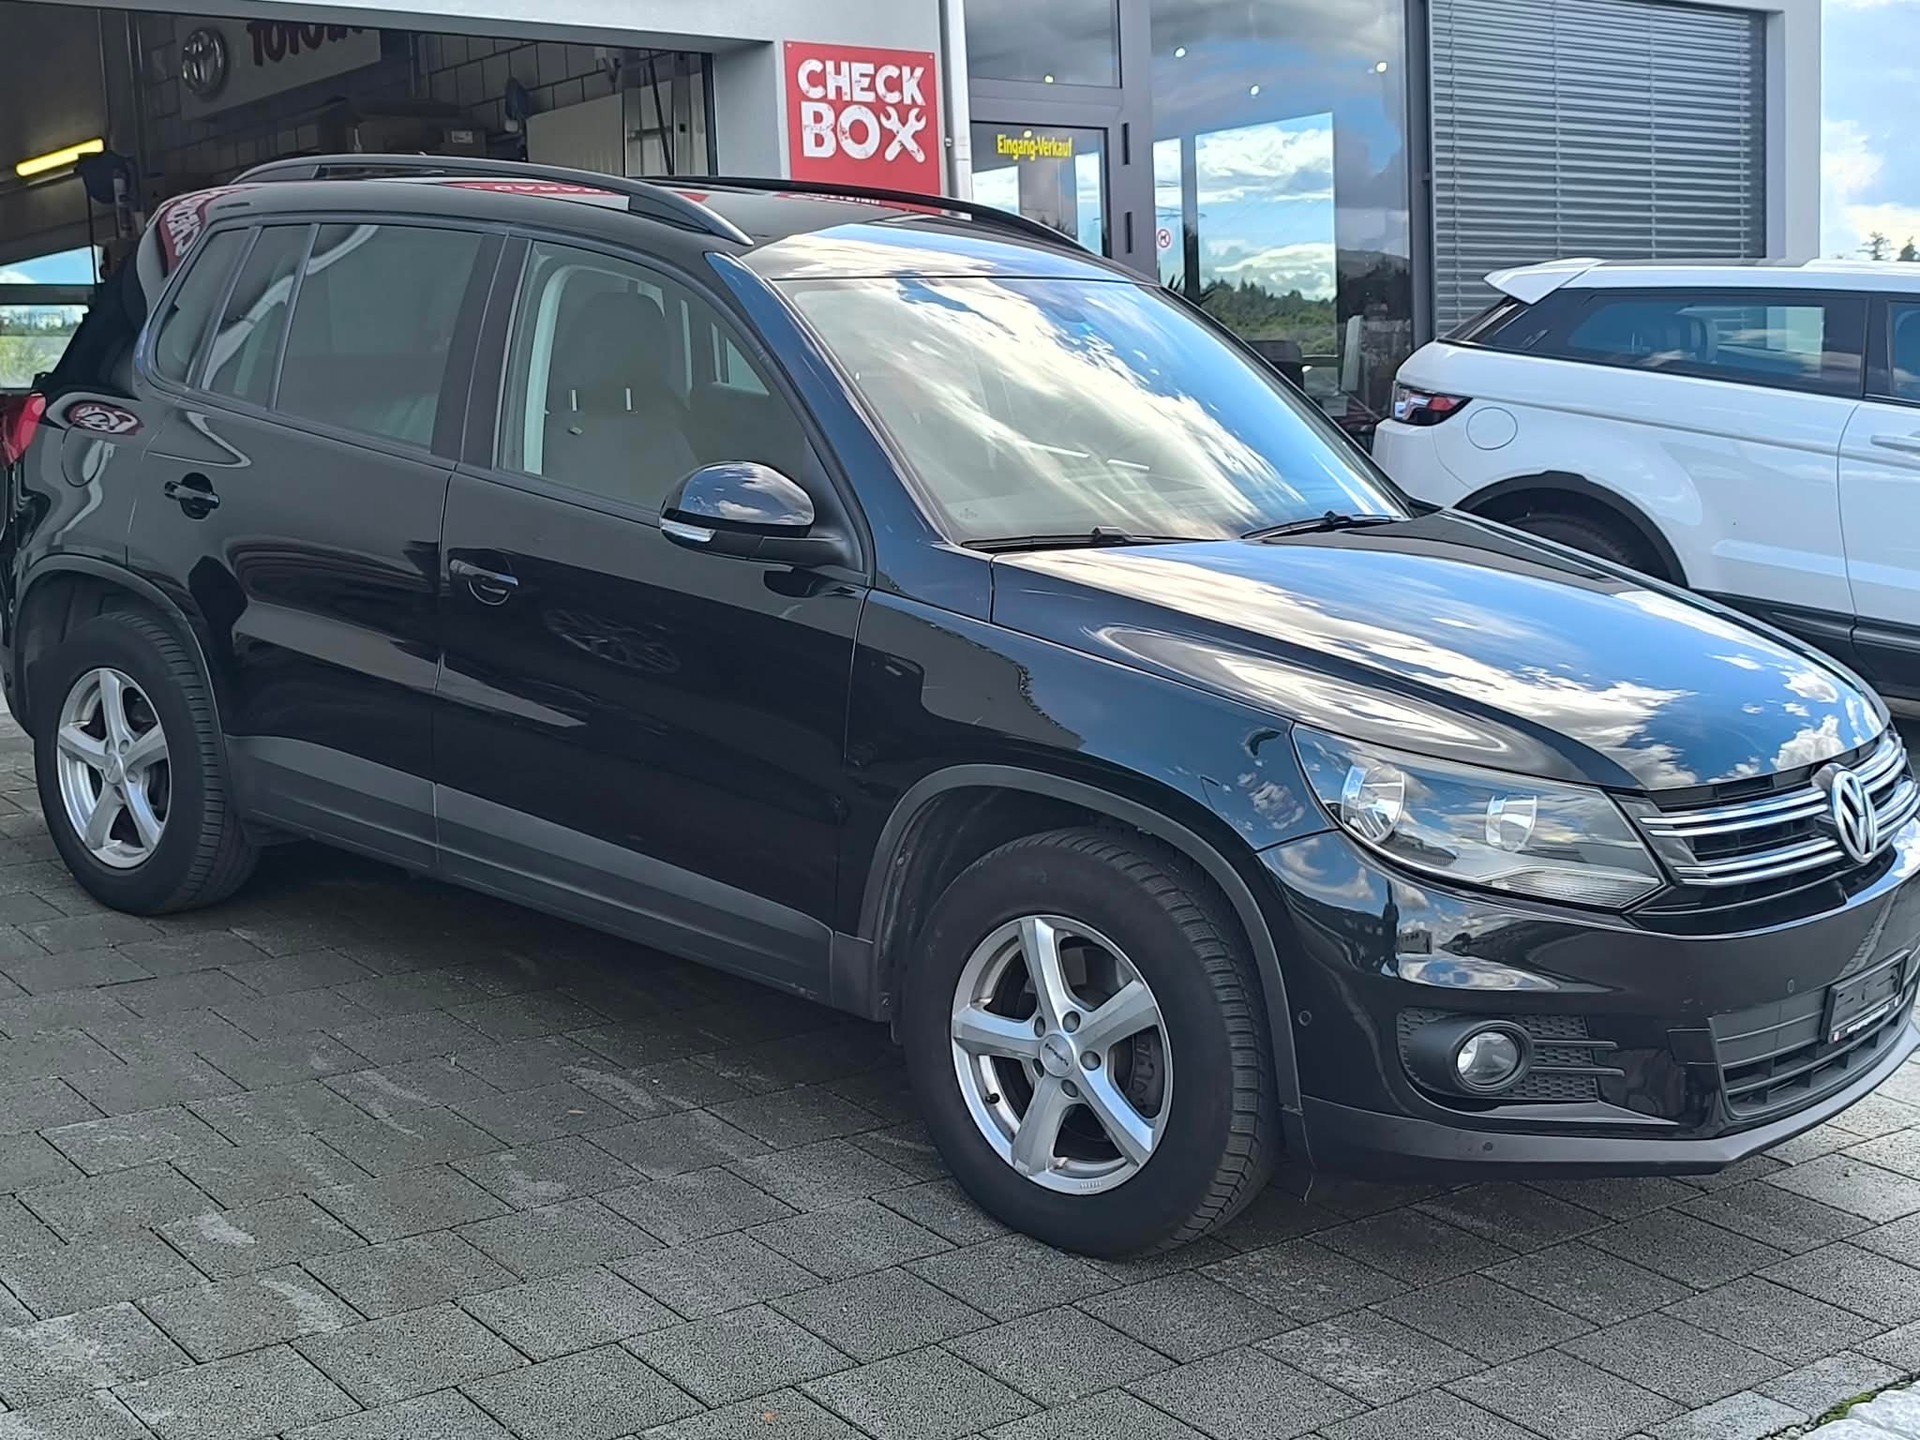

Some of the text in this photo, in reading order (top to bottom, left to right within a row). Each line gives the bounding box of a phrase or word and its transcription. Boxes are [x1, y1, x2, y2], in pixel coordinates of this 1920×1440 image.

[246, 20, 363, 67] TOYO
[797, 58, 926, 106] CHECK
[800, 100, 927, 163] BOX
[997, 134, 1073, 161] Eingang-Verkauf
